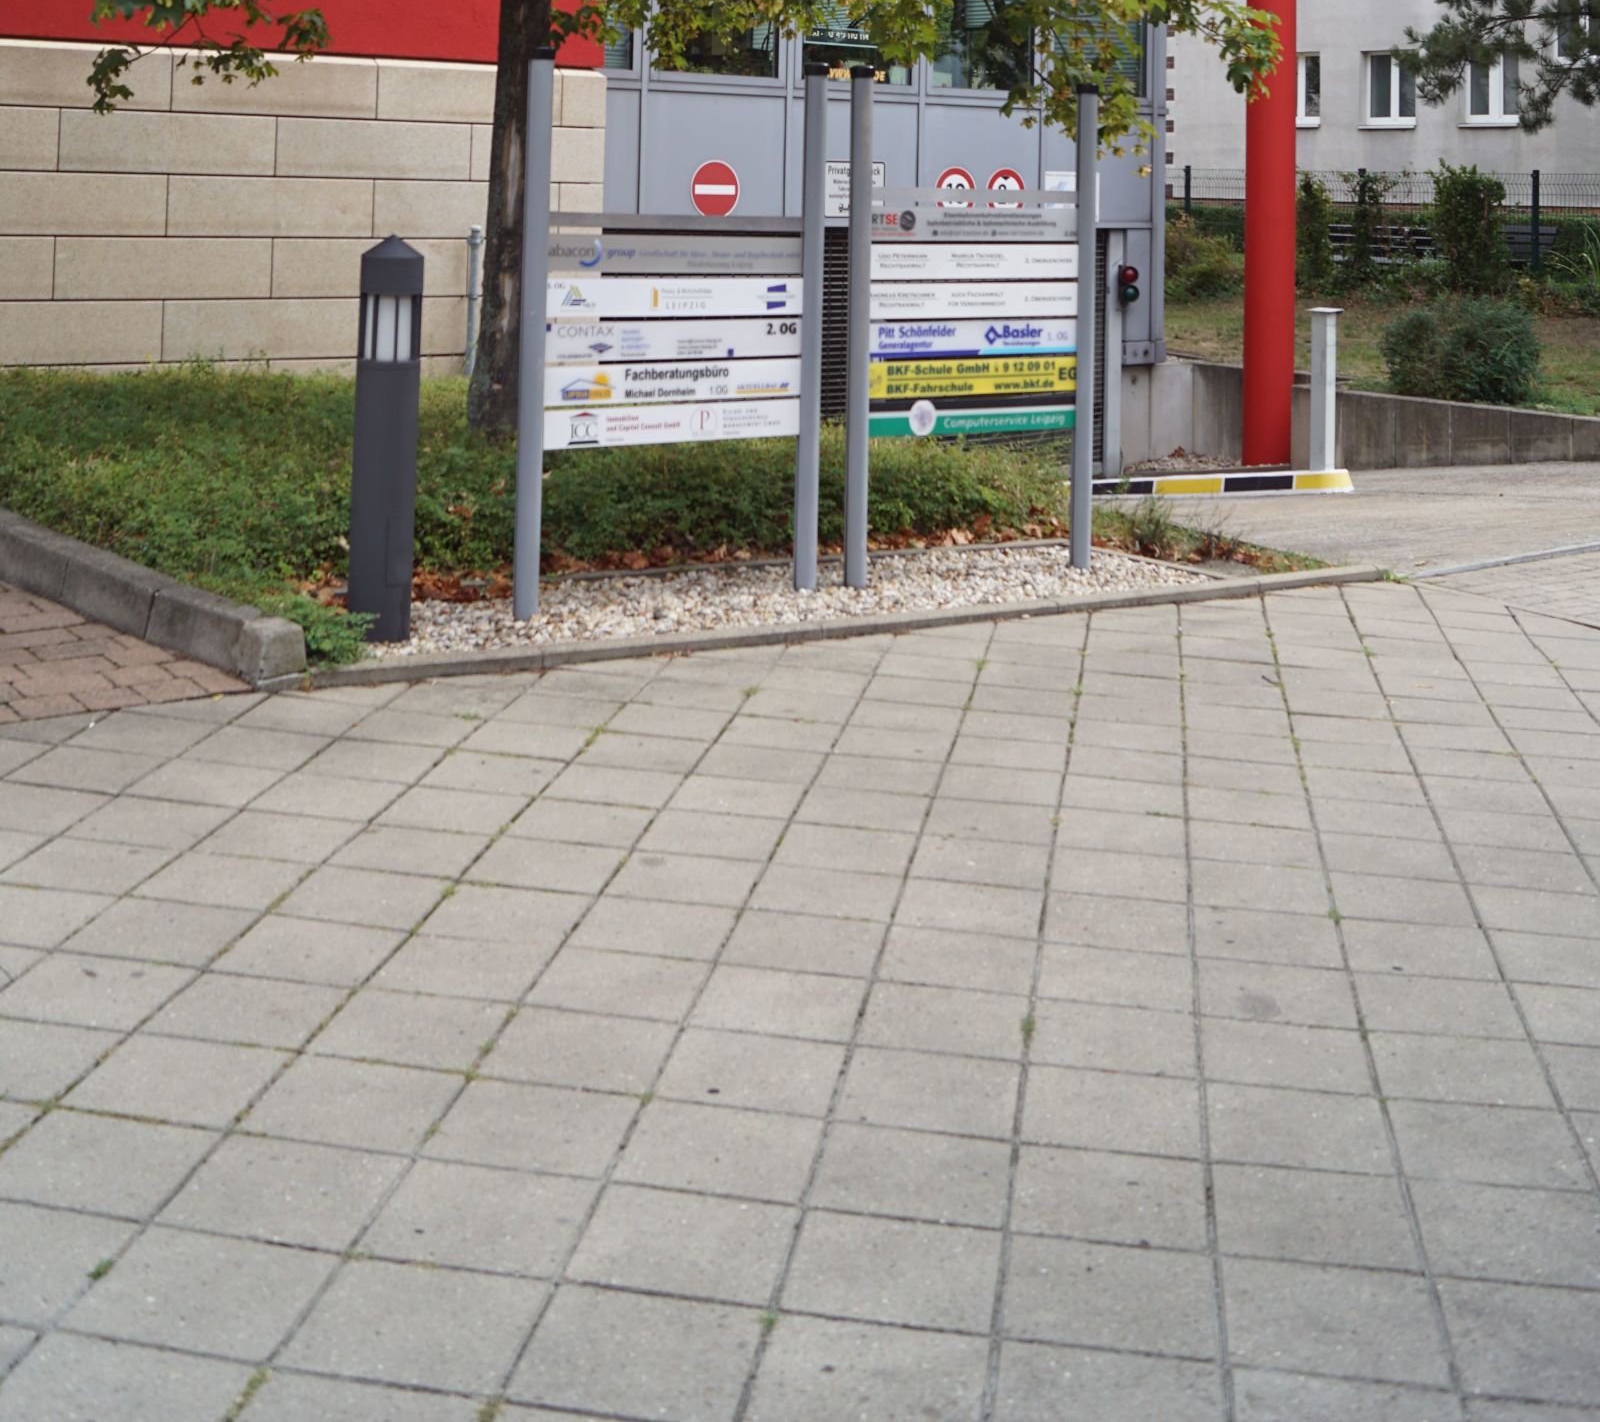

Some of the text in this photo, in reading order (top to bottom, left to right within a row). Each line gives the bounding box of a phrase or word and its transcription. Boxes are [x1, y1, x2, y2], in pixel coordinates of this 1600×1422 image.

[548, 243, 596, 258] abacon
[606, 247, 637, 259] group
[557, 325, 615, 338] CONTAX
[766, 322, 798, 335] 2. OG
[878, 325, 957, 338] Pitt Schönfelder
[1003, 323, 1044, 338] Basler
[878, 340, 933, 352] Generalagentur
[624, 366, 730, 383] Fachberatungsbüro
[887, 360, 1055, 376] BKF-Schule GmbH 9 12 09 01
[1058, 366, 1077, 381] EG
[624, 388, 656, 399] Michael
[658, 386, 696, 398] Dornheim
[887, 379, 1055, 394] BKF-Fahrschule www.bkf.de
[943, 414, 1066, 429] Computerservice Leipzig
